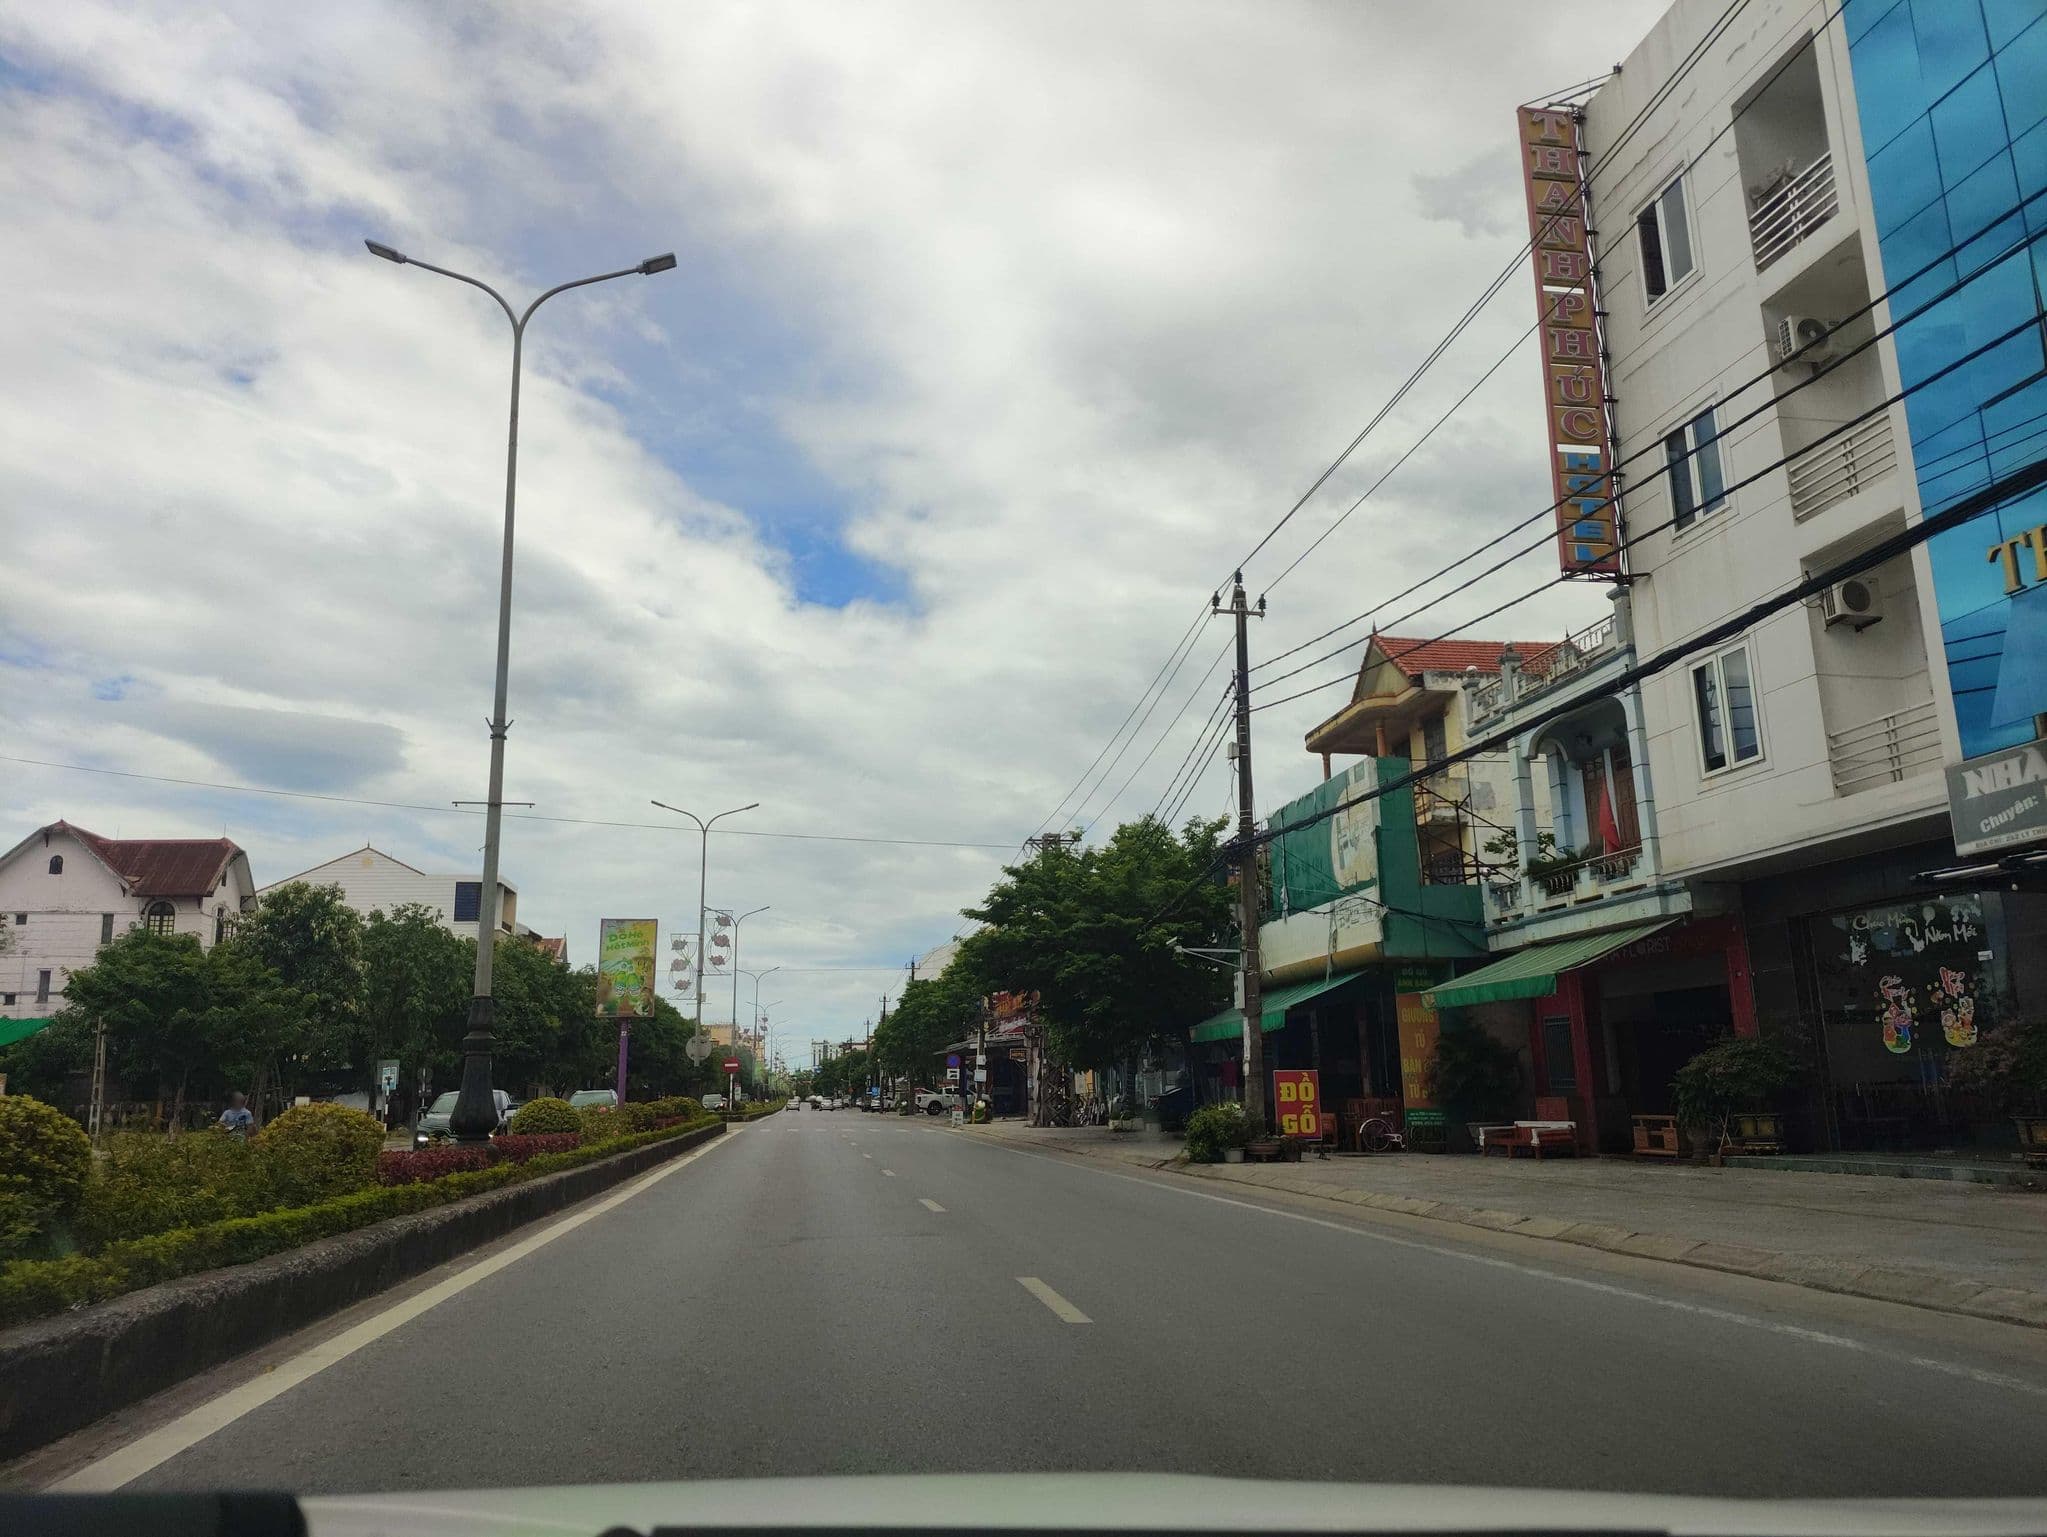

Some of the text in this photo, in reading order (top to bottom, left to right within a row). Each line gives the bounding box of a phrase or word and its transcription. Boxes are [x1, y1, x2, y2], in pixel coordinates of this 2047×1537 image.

[1530, 111, 1609, 564] THANH PHÚC HOTEL
[1279, 1072, 1315, 1102] ĐỒ
[1282, 1104, 1316, 1134] GỖ
